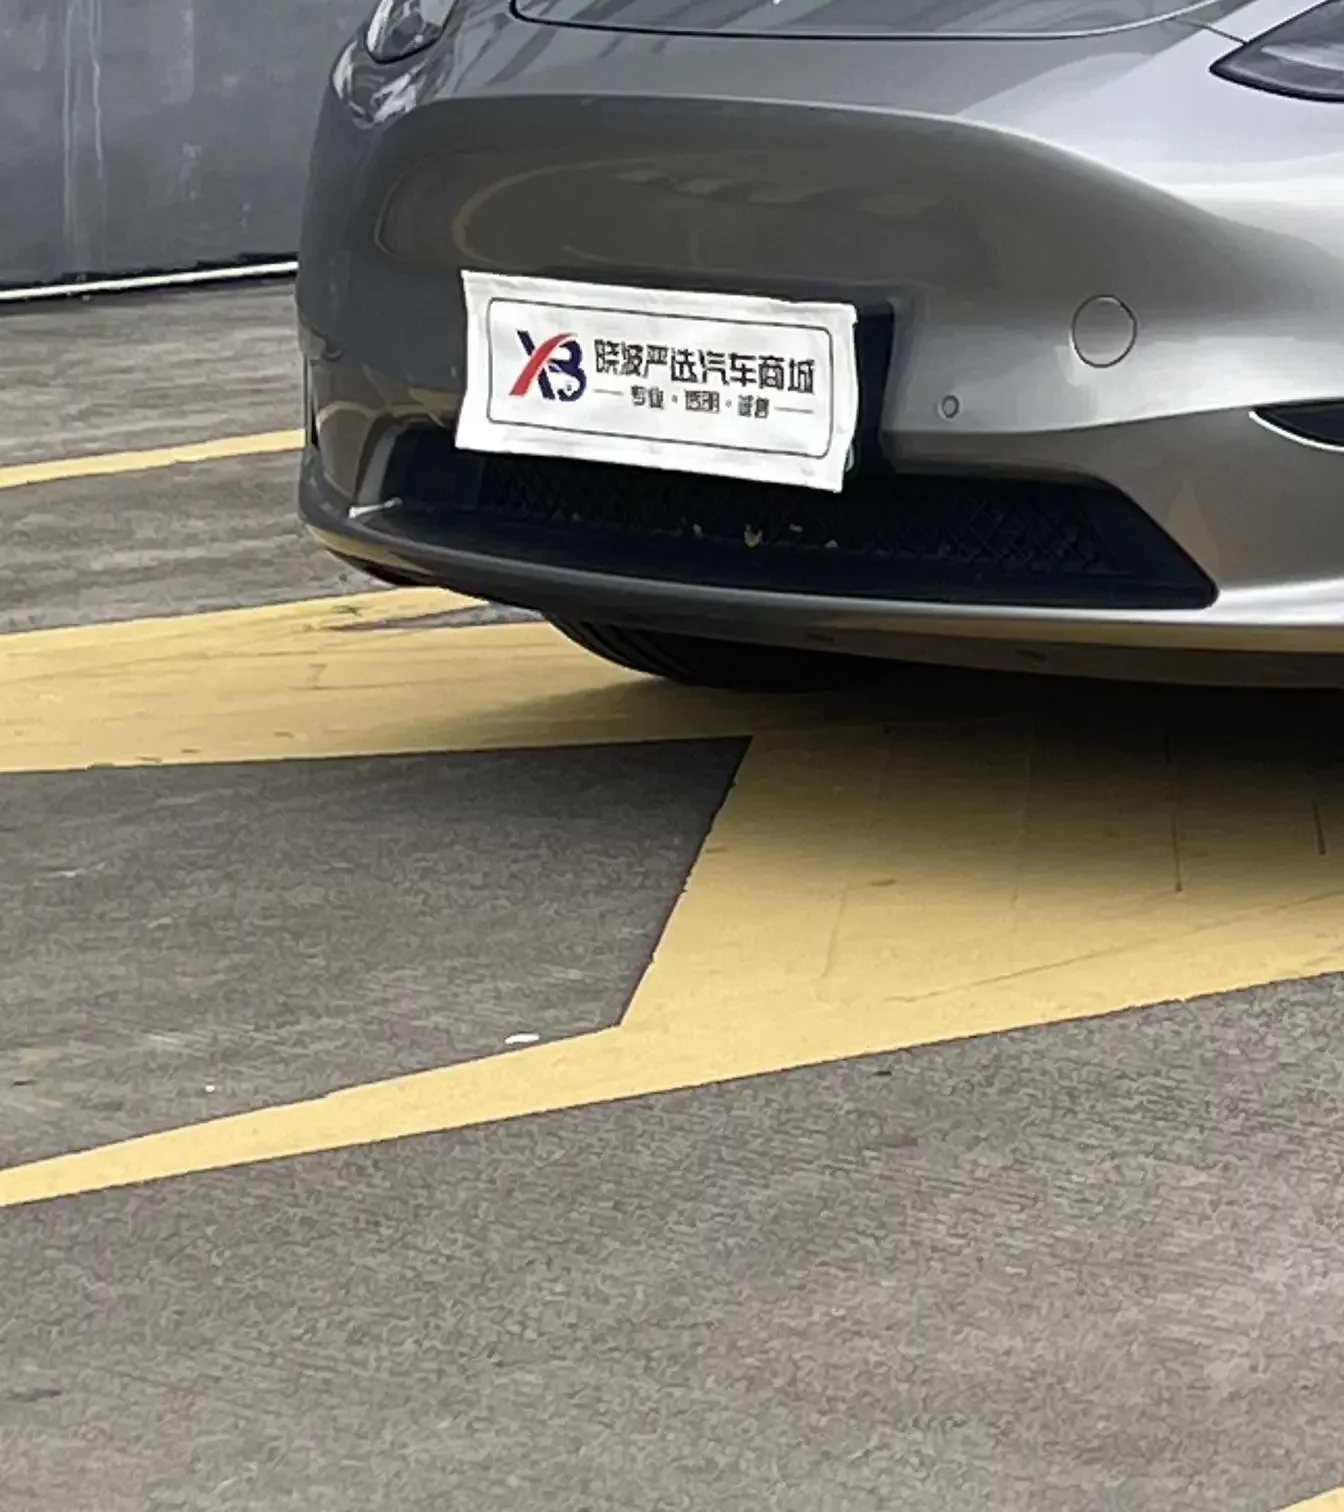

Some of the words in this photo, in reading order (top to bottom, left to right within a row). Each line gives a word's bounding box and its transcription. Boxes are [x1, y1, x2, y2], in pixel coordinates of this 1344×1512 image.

[594, 339, 815, 394] 晓波严选汽车商城
